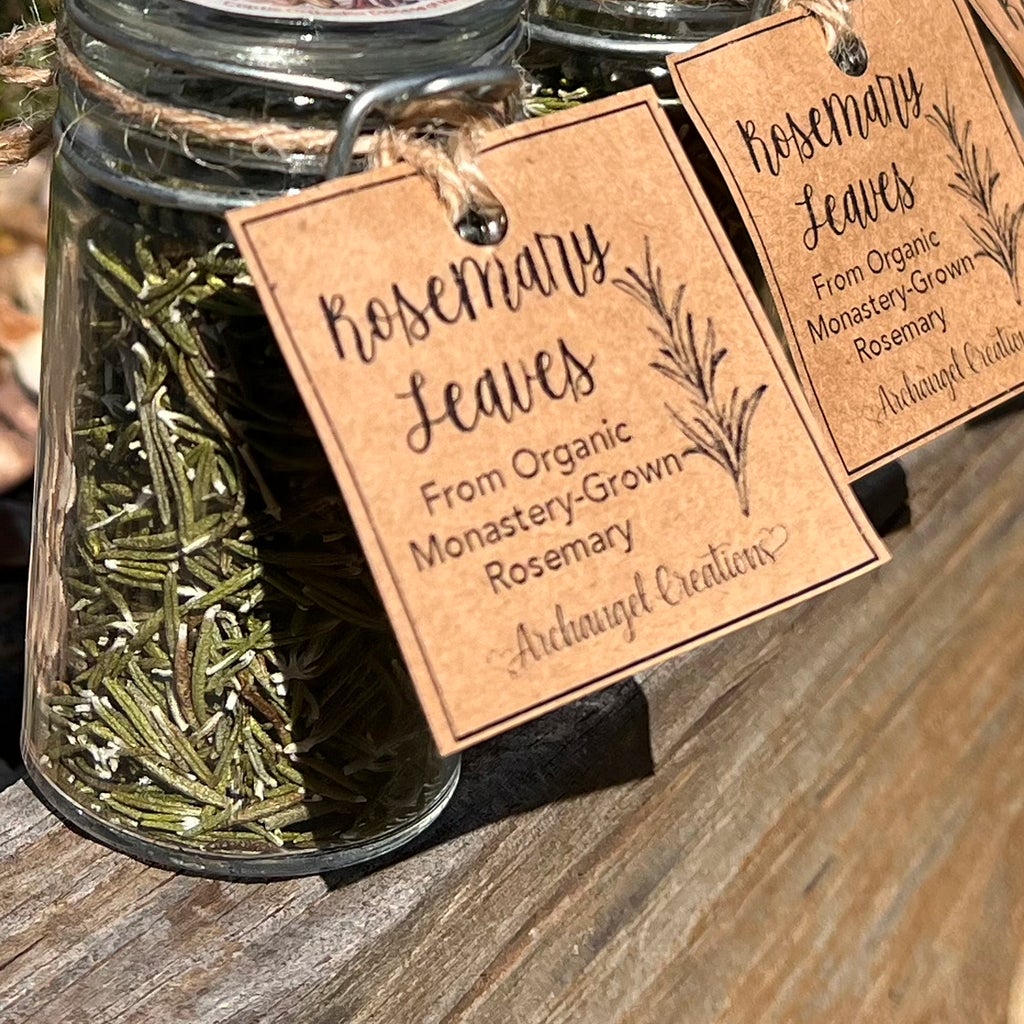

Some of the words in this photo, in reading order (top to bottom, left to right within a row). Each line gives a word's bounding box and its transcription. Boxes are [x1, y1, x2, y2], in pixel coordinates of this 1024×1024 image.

[735, 66, 925, 176] Rosemary
[794, 162, 916, 251] Leaves
[318, 222, 612, 364] Rosemary
[806, 254, 976, 344] Monastery-Grown
[811, 266, 865, 301] From
[866, 227, 941, 277] Organic
[854, 306, 948, 364] Rosemary
[393, 337, 597, 455] Leaves
[869, 346, 966, 425] Archangel
[407, 451, 686, 574] Monastery-Grown
[420, 471, 507, 517] From
[510, 420, 632, 483] Organic
[483, 519, 635, 595] Rosemary
[506, 571, 653, 675] Archangel
[655, 543, 777, 607] Creations
